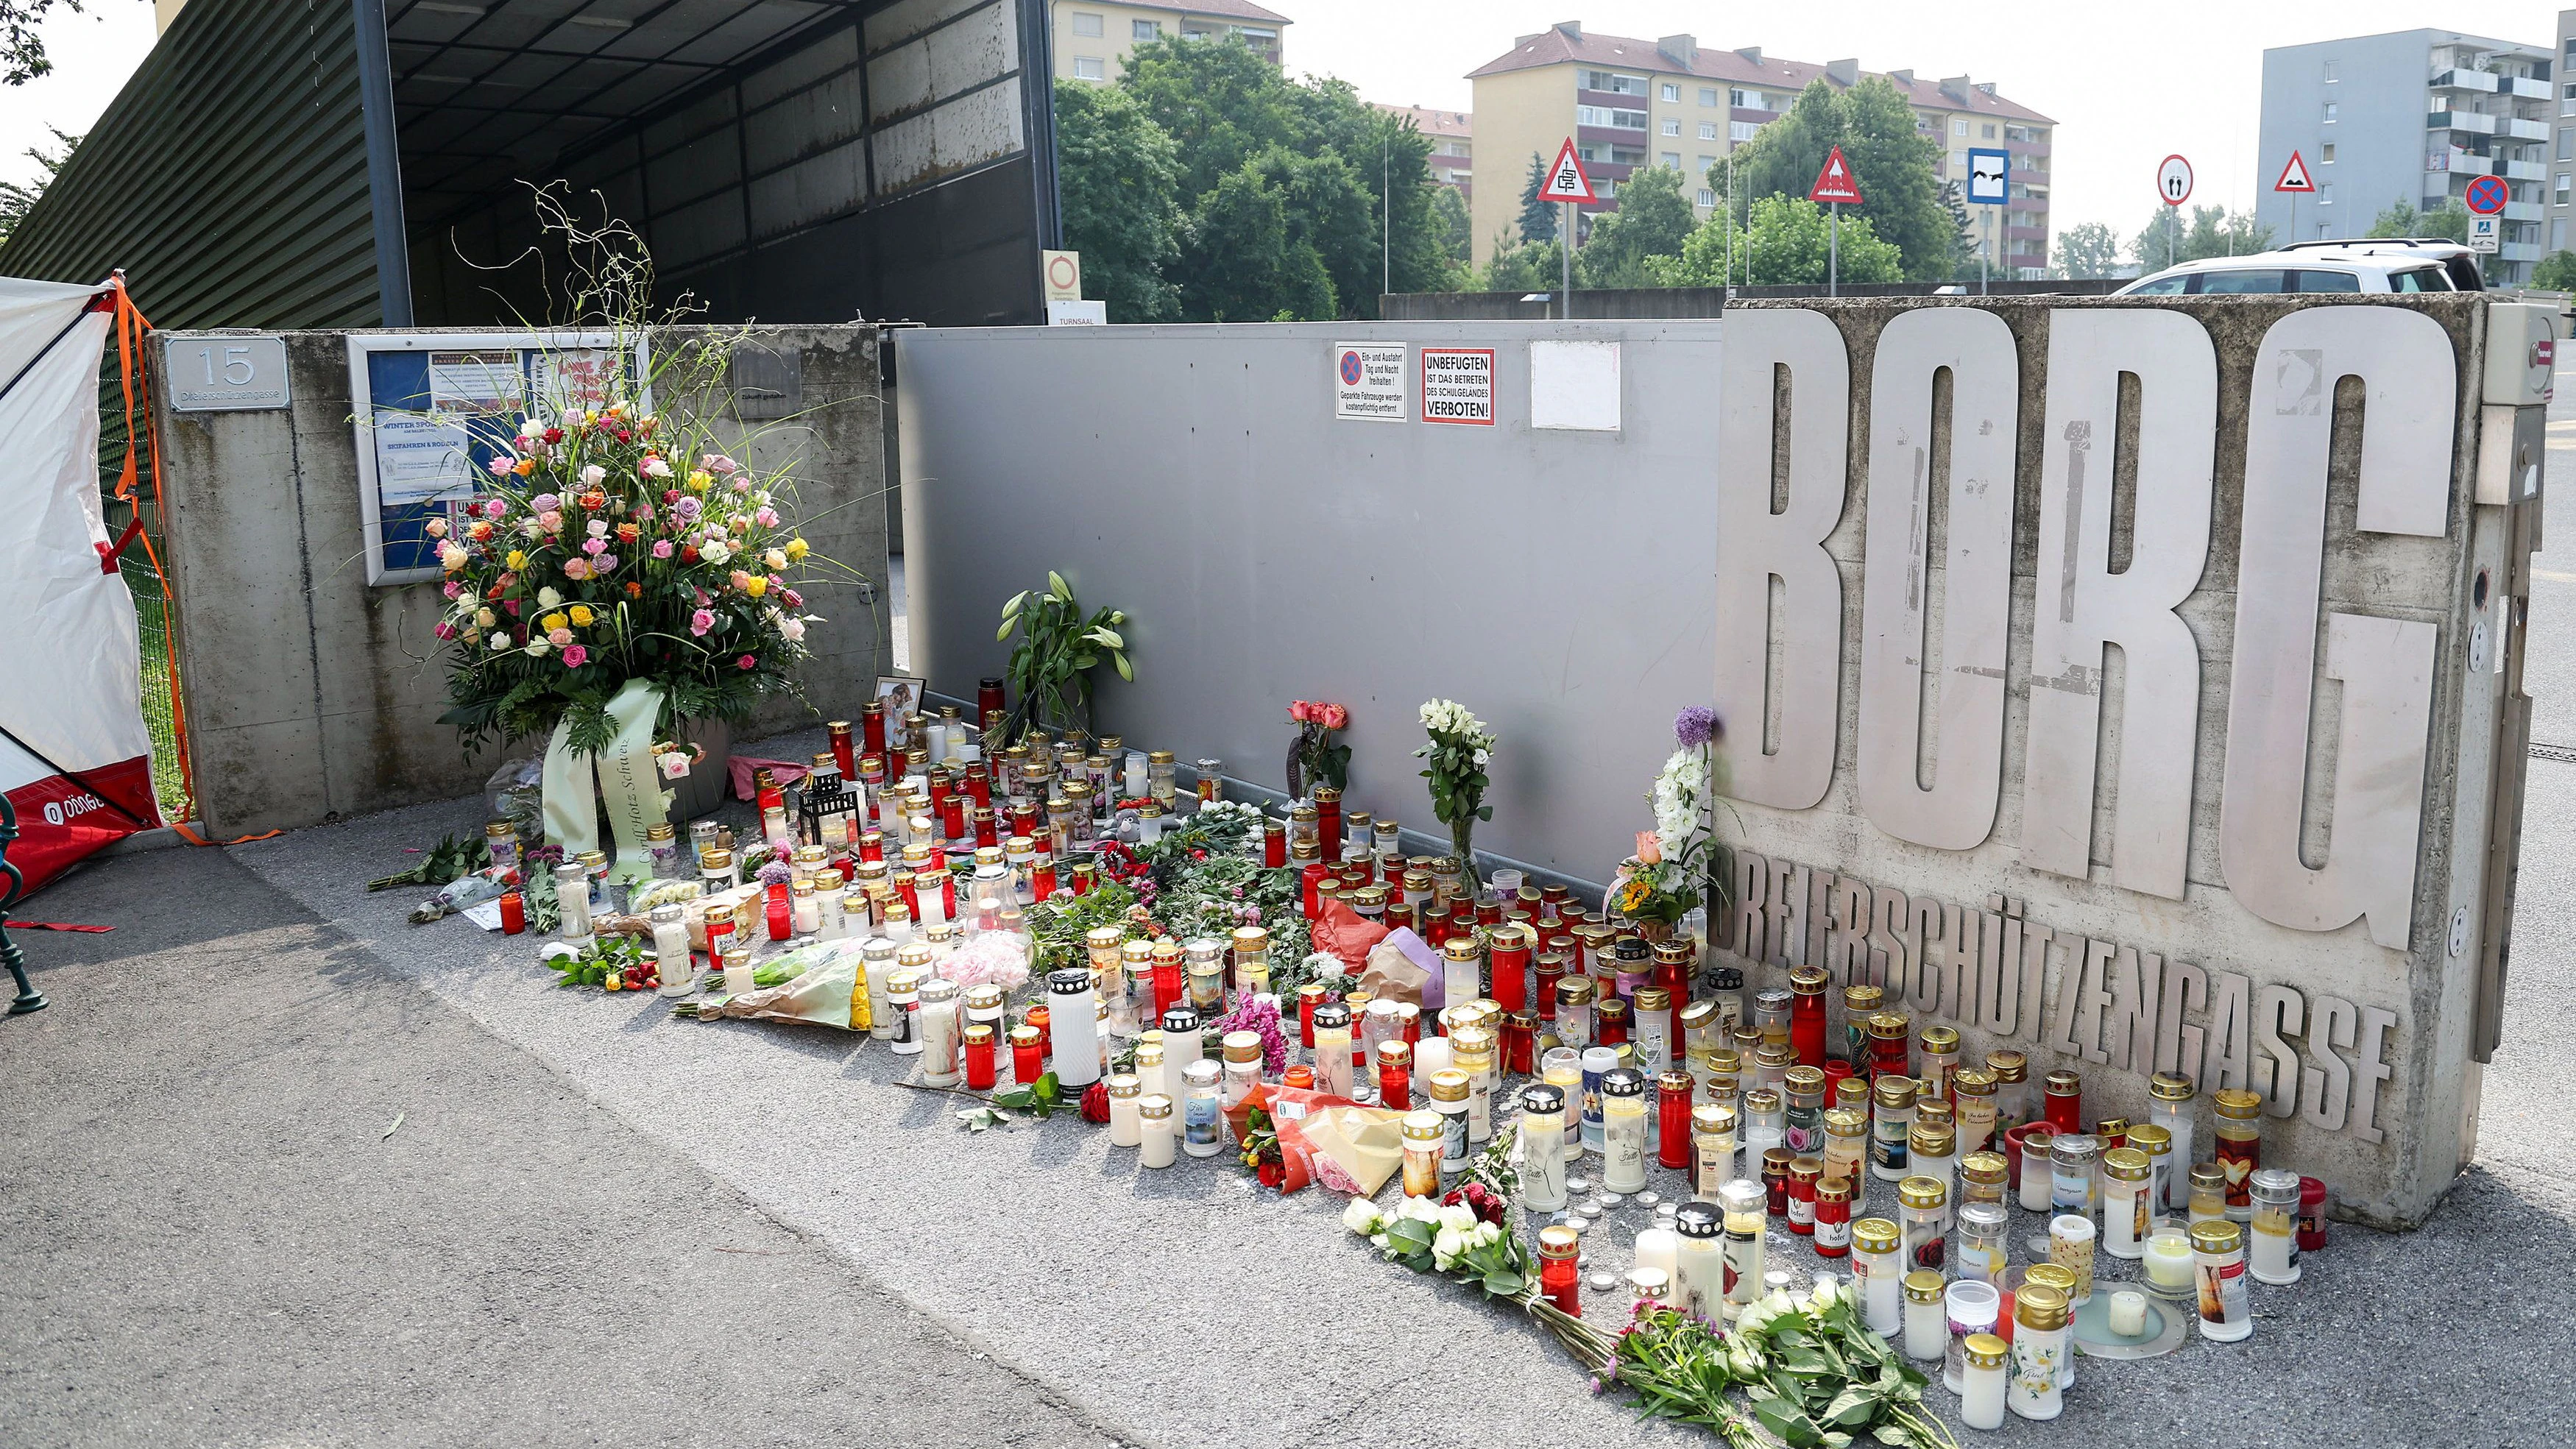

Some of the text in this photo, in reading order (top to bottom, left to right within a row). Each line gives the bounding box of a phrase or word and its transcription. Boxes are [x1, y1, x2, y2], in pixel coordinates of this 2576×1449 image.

[1362, 352, 1402, 362] Ein- und Ausfahrt
[199, 347, 255, 386] 15
[1426, 356, 1487, 370] UNBEFUGTEN
[1365, 364, 1398, 375] Tag und Nacht
[1369, 376, 1391, 386] freihalten
[1427, 374, 1488, 384] IST DAS BETRETEN
[181, 390, 280, 401] Dreierschützengasse
[1340, 391, 1402, 402] Geparkte Fahrzeuge werden
[1426, 386, 1488, 397] DES SCHULGELÄNDES
[1345, 402, 1397, 413] kostenpflichtig entfernt
[1427, 401, 1488, 417] VERBOTEN!
[1713, 305, 2456, 952] BORG
[617, 737, 635, 790] Schweiz
[627, 794, 644, 827] Hotz
[1707, 844, 2396, 1145] DREIERSCHÜTZENGASSE
[1618, 1150, 1638, 1161] Stille
[1526, 1166, 1541, 1178] Stille
[1791, 1208, 1805, 1218] hofer
